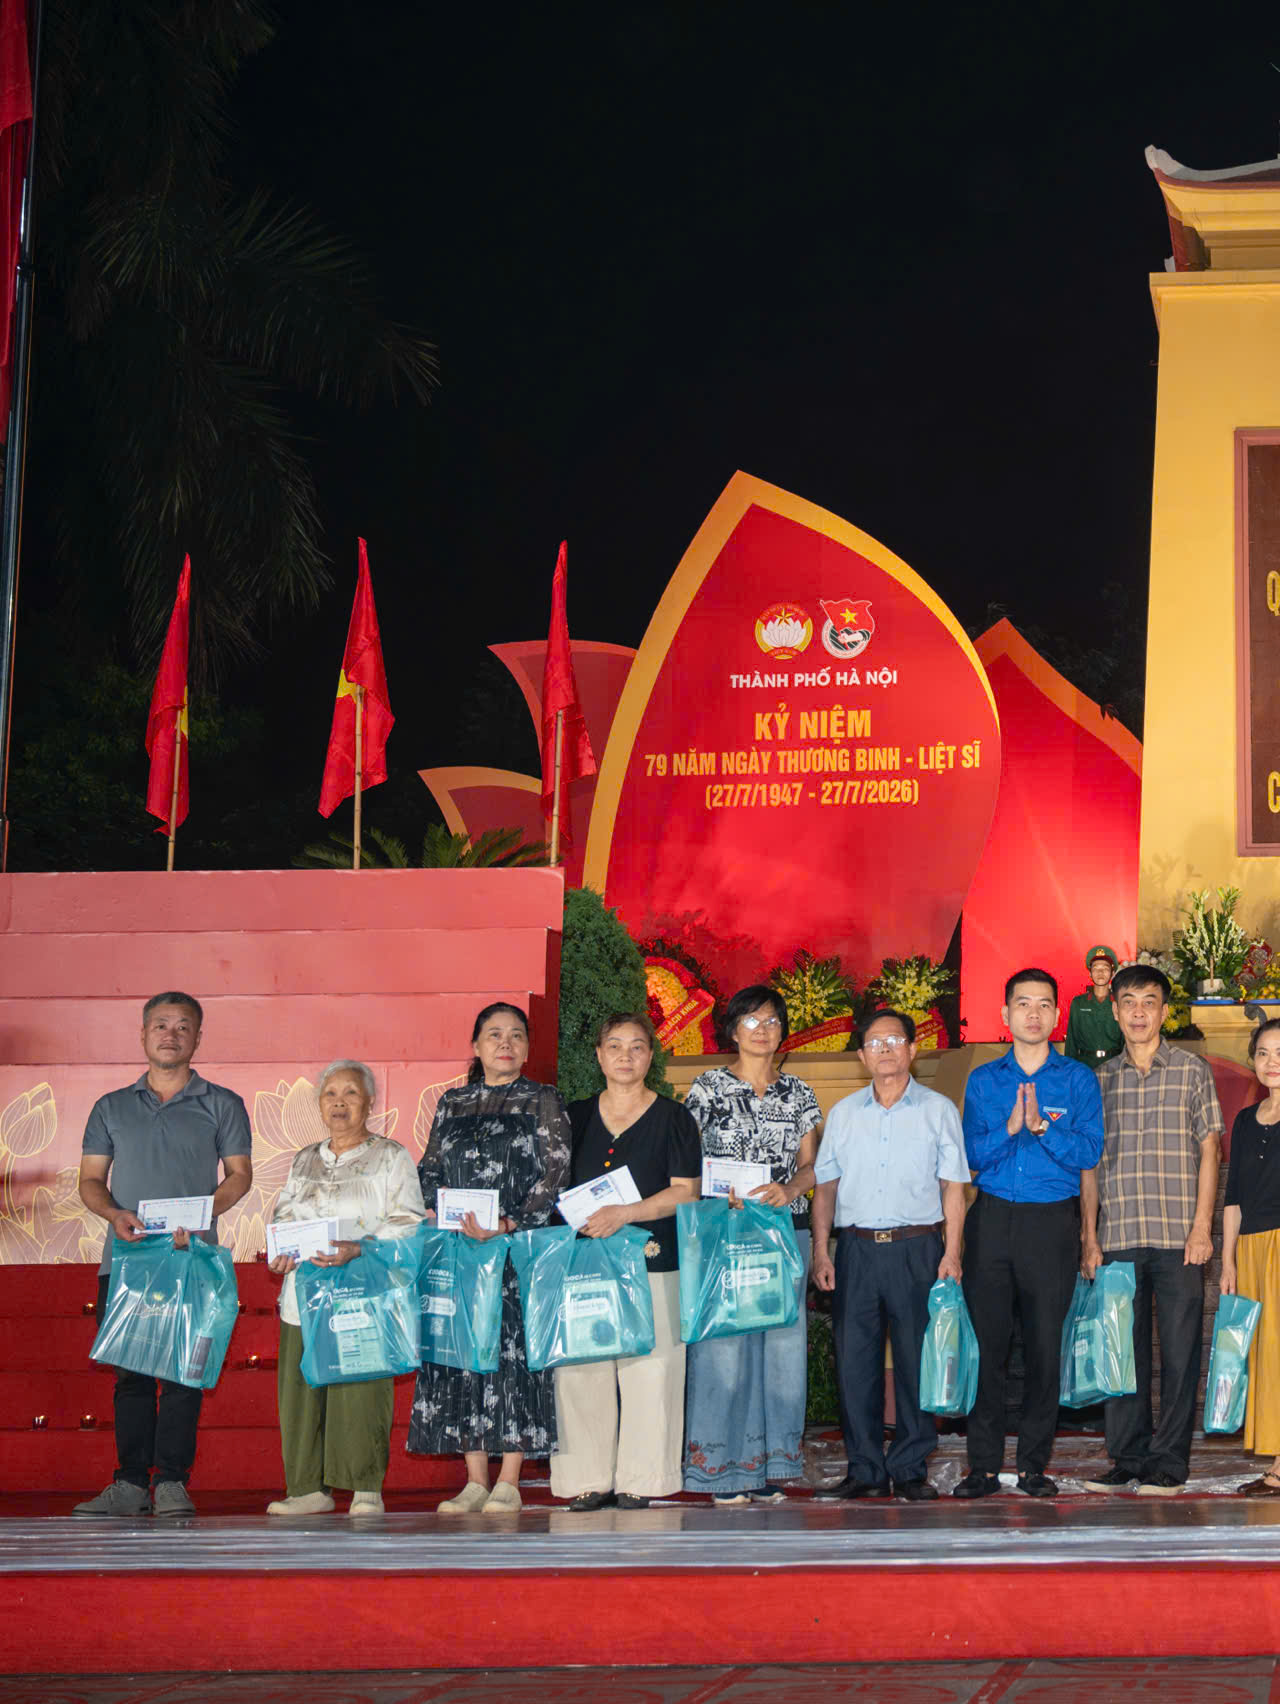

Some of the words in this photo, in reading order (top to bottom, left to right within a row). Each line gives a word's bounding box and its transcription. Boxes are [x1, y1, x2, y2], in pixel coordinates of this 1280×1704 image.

[730, 670, 789, 689] THÀNH
[794, 666, 832, 687] PHỐ
[836, 668, 861, 686] HÀ
[866, 667, 898, 688] NỘI
[755, 702, 791, 741] KỶ
[800, 704, 872, 744] NIỆM
[644, 753, 668, 777] 79
[673, 748, 716, 777] NĂM
[722, 746, 772, 775] NGÀY
[777, 746, 850, 774] THƯƠNG
[855, 747, 900, 771] BINH
[919, 741, 956, 775] LIỆT
[961, 739, 982, 768] SĨ
[705, 782, 803, 810] (27/7/1947
[821, 779, 920, 805] 27/7/2026)
